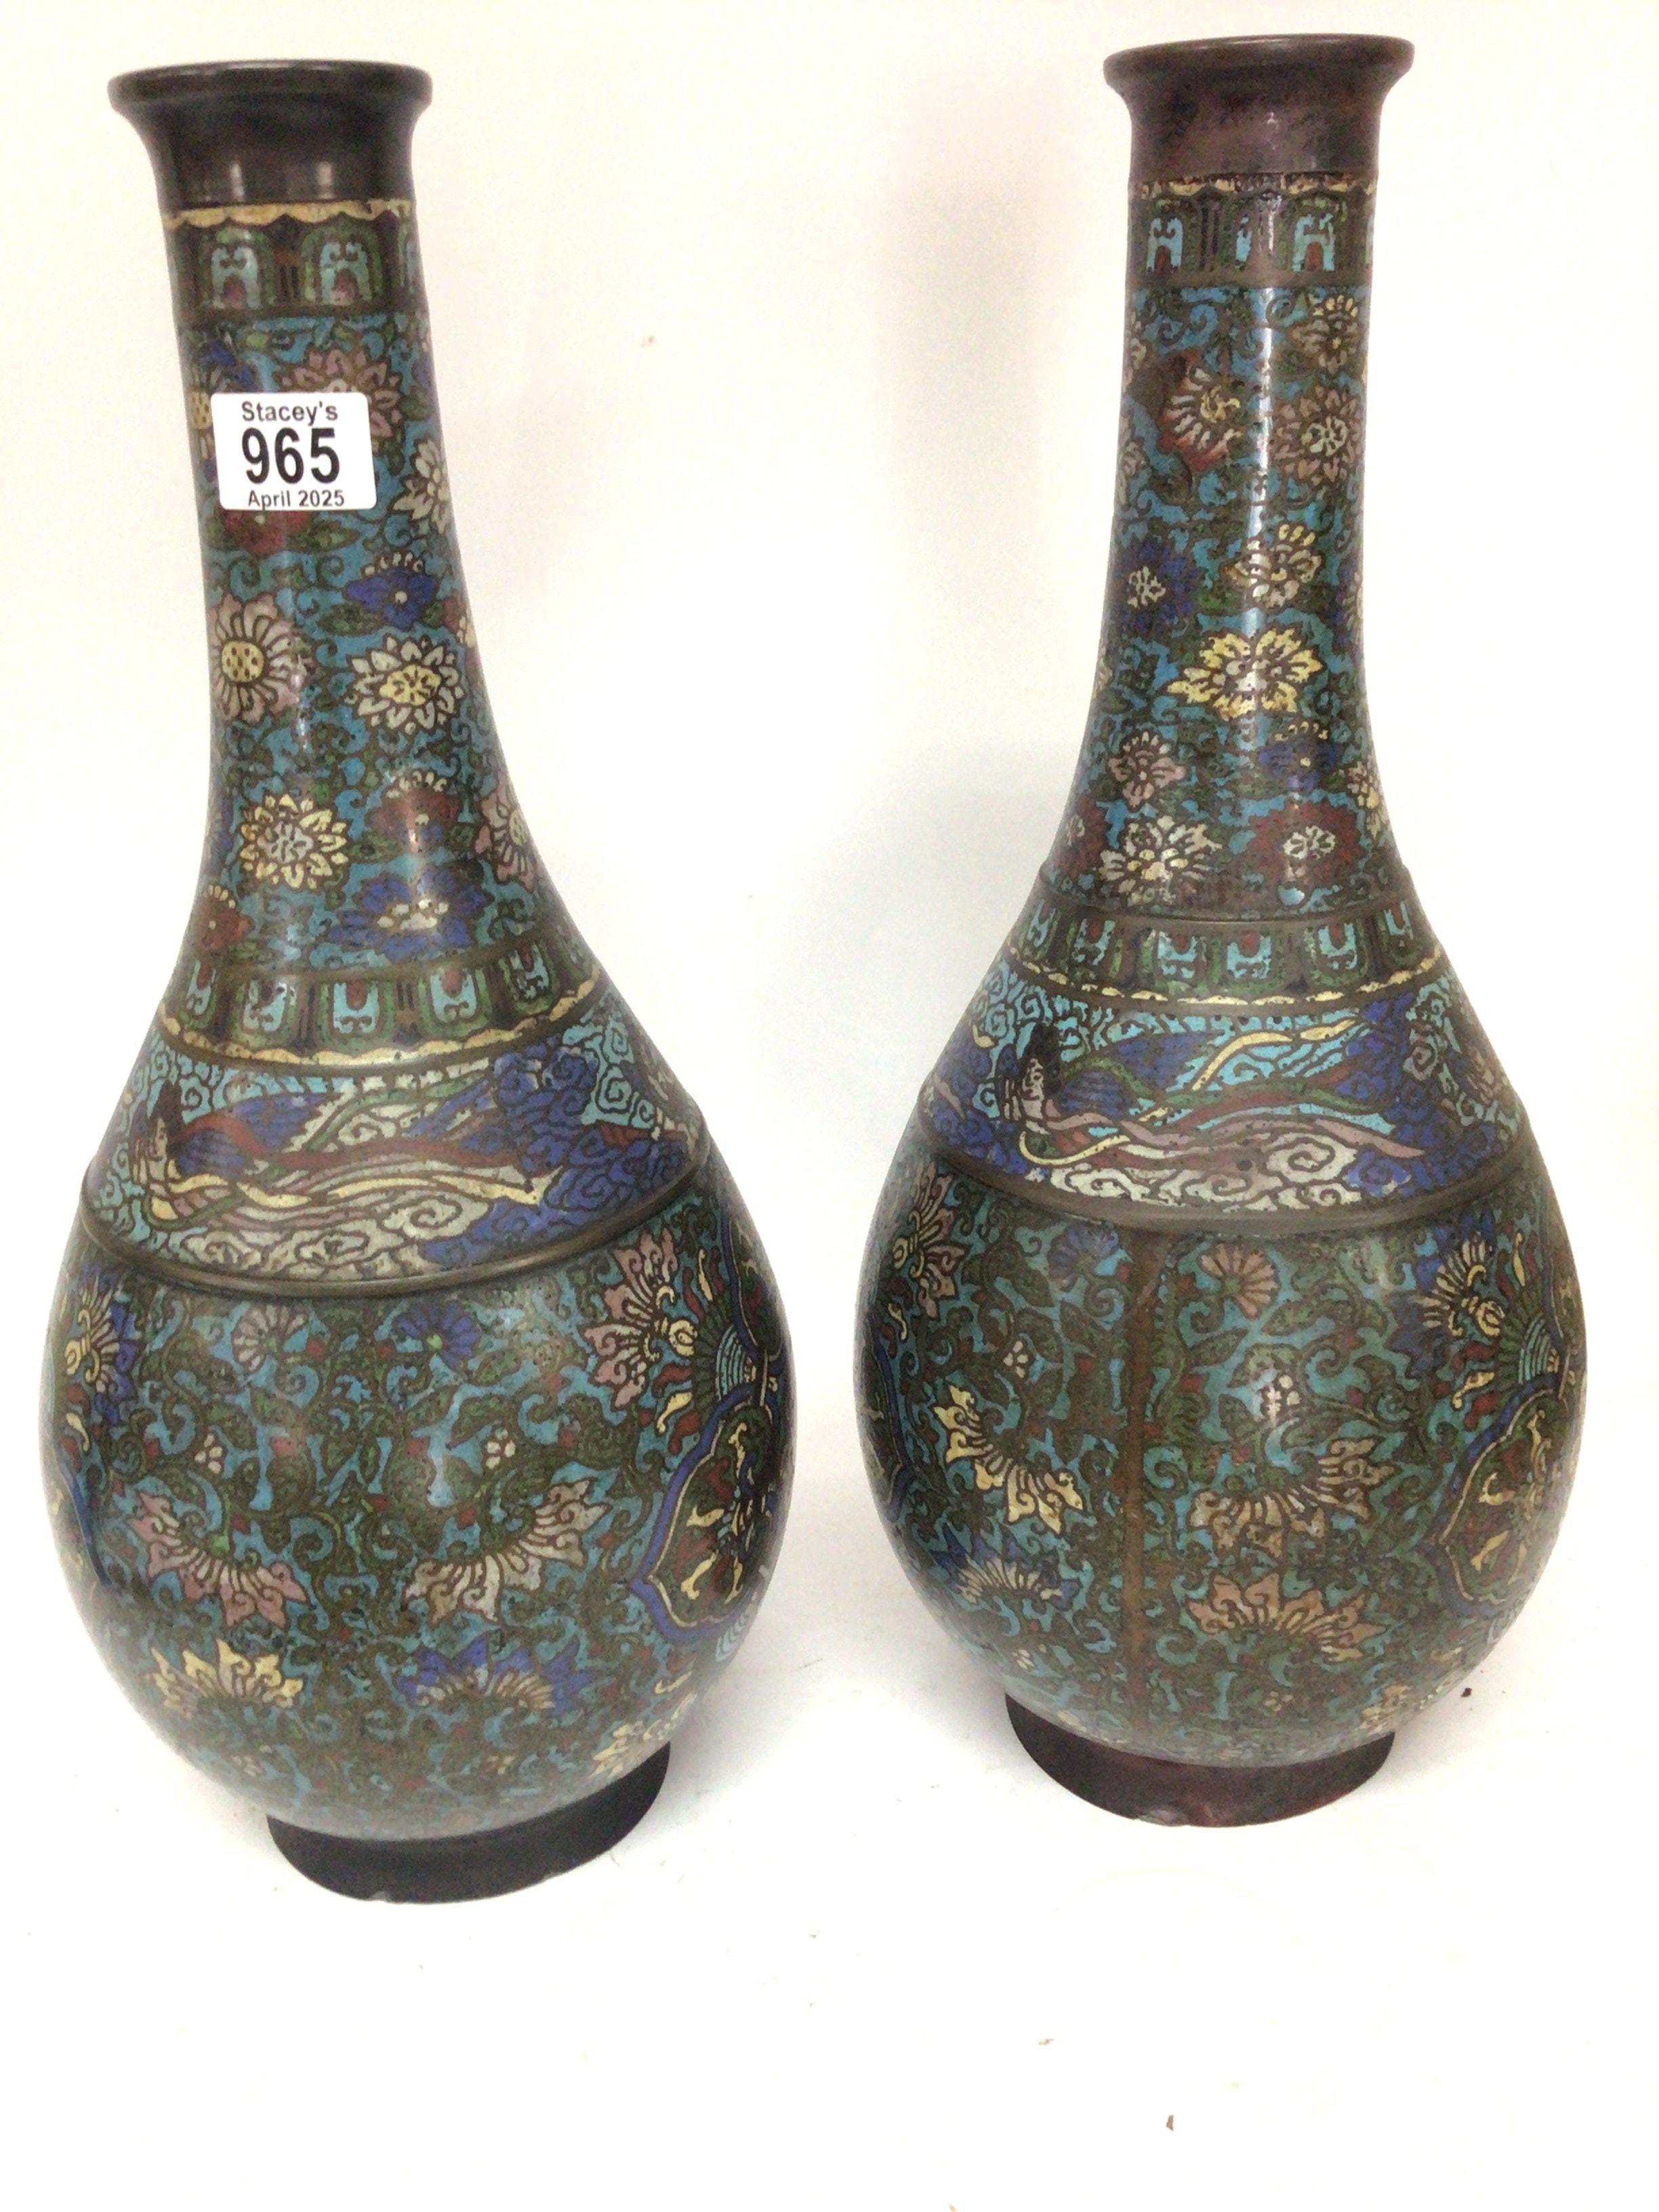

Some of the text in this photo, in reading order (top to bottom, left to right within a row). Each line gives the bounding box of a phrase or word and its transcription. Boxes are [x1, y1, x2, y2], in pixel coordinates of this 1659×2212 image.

[241, 401, 338, 426] Stacey's
[241, 427, 340, 485] 965
[248, 489, 345, 510] April 2025
